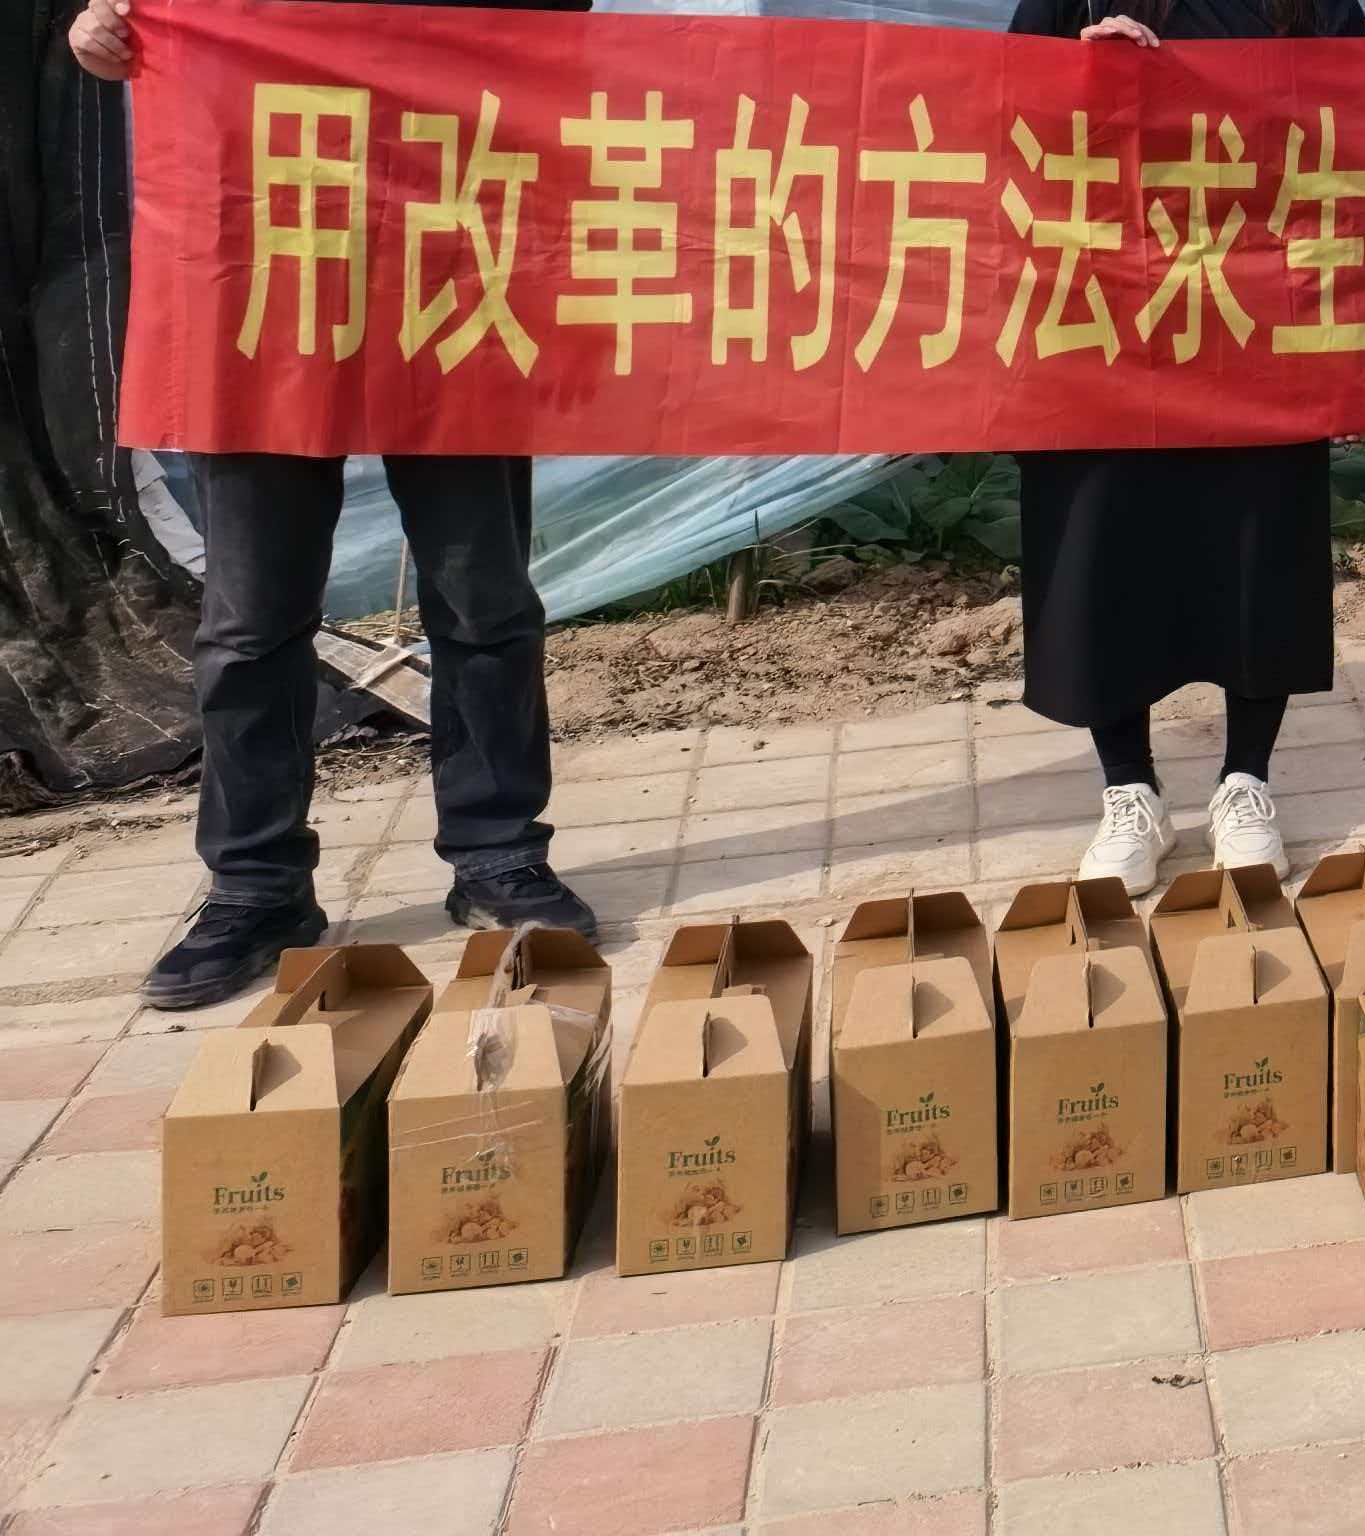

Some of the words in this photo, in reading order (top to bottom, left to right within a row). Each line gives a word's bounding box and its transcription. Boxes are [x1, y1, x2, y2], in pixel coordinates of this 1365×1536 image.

[1224, 1067, 1283, 1090] Fruits
[1057, 1093, 1119, 1115] Fruits
[886, 1104, 951, 1127] Fruits
[667, 1147, 736, 1169] Fruits
[441, 1163, 511, 1184] Fruits
[213, 1184, 285, 1205] Fruits
